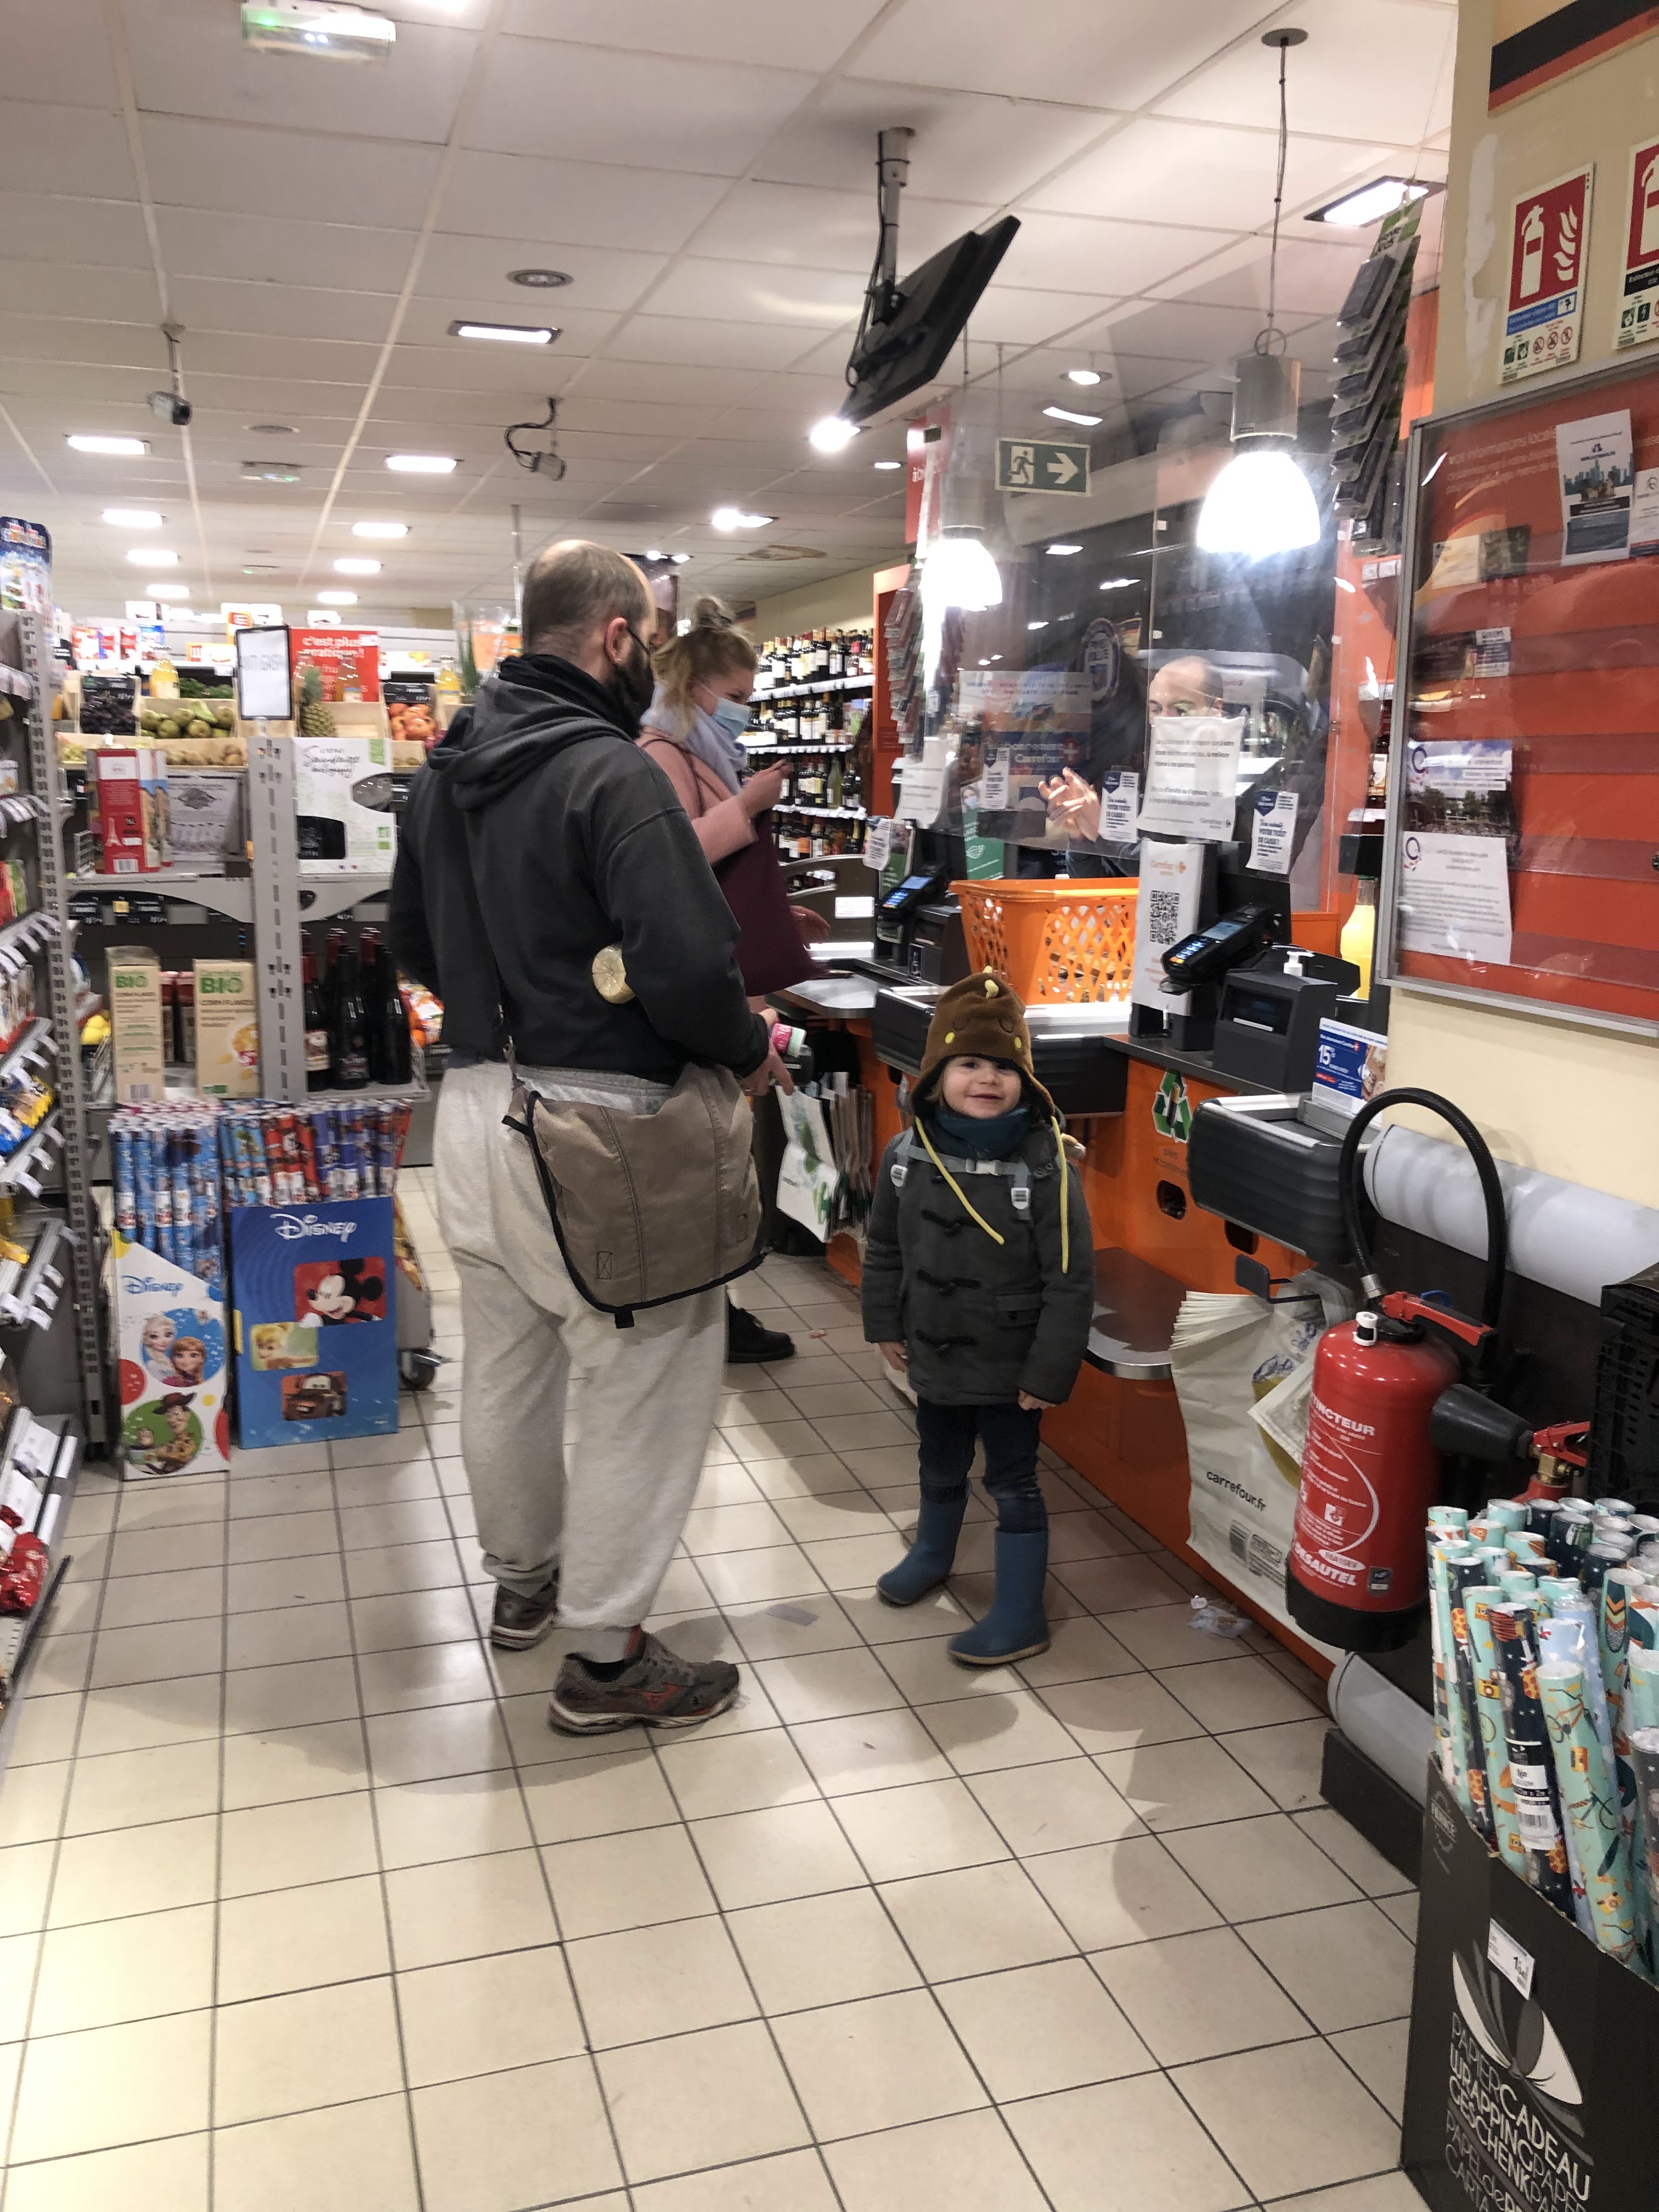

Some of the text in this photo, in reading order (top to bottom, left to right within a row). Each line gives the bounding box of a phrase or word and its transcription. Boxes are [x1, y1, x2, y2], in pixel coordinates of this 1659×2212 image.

[115, 976, 148, 988] BIO
[200, 977, 244, 994] BIO
[1206, 1471, 1266, 1512] carrefour.fr
